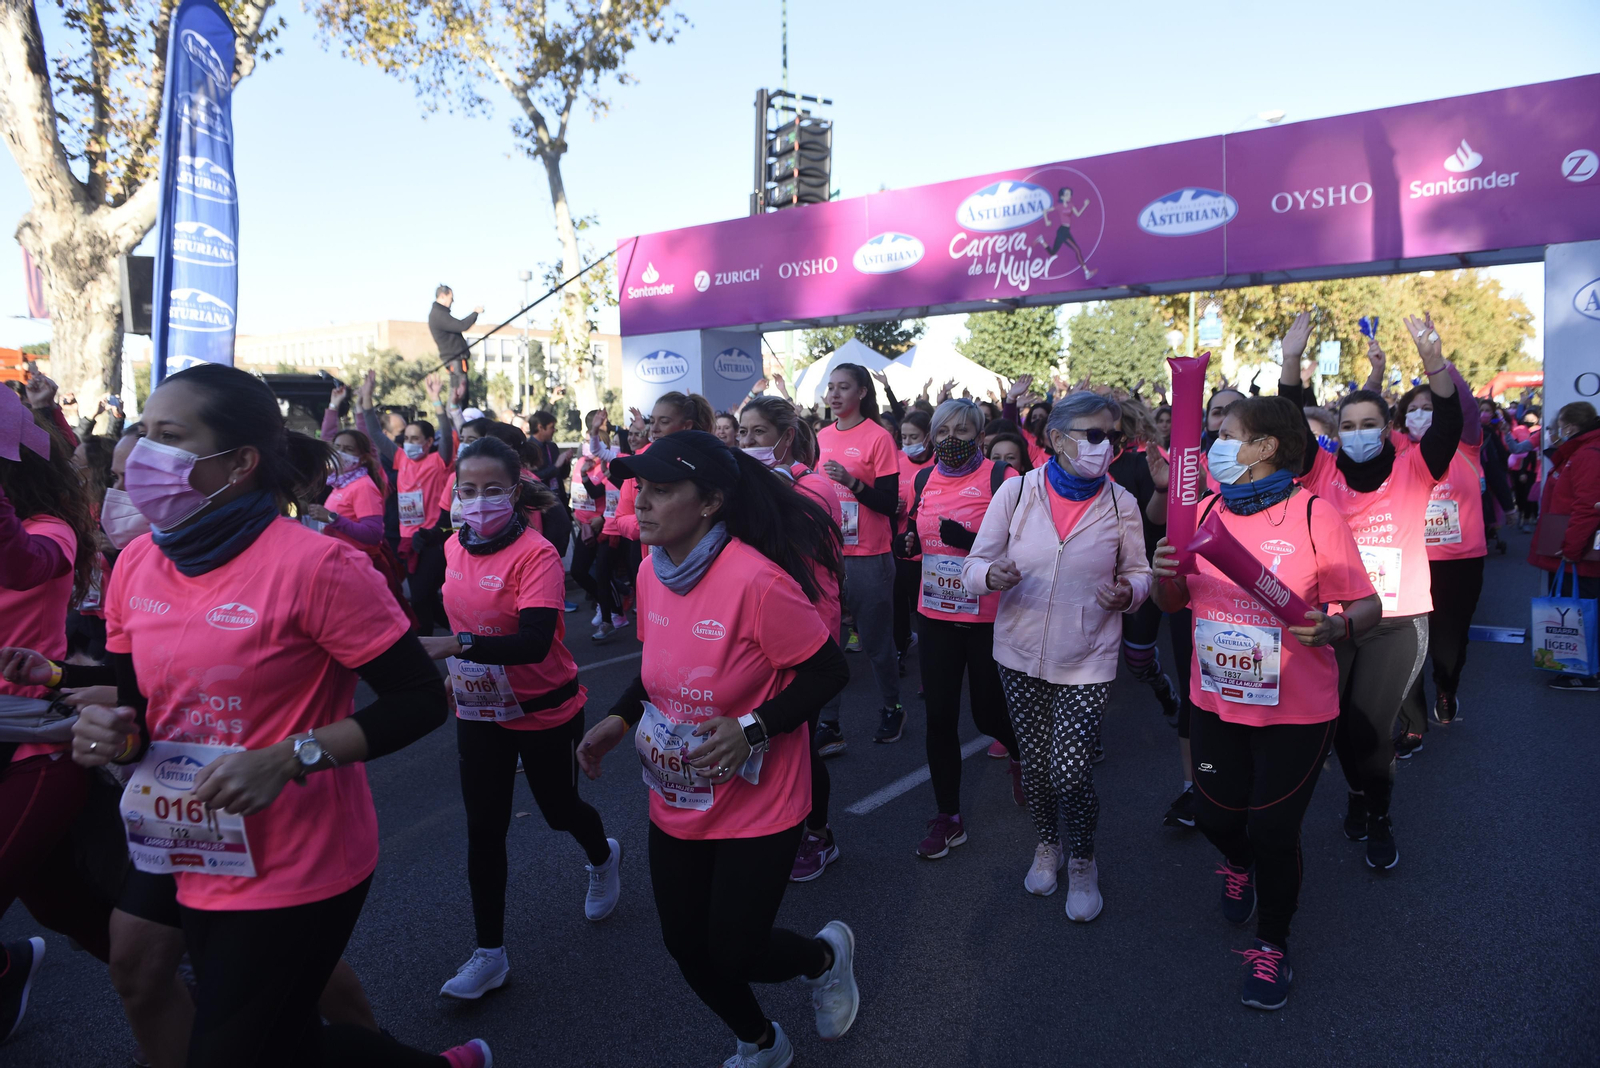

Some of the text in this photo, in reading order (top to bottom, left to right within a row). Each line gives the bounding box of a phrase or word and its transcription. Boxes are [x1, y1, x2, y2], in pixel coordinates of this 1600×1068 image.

[177, 171, 234, 197] STURIAN
[1410, 171, 1519, 198] Santander
[1271, 182, 1373, 213] OYSHO
[965, 200, 1044, 222] ASTURIANA
[1147, 206, 1229, 228] ASTURIANA
[174, 239, 235, 264] STURIANA
[949, 232, 1027, 259] Carrera
[863, 249, 918, 266] ASTURIANA
[779, 256, 838, 279] OYSHO
[968, 247, 1058, 291] de la Mujer
[715, 268, 760, 286] ZURICH
[627, 283, 674, 299] Santander
[169, 306, 230, 326] STURIANA
[641, 363, 685, 376] ASTURIANA
[717, 359, 753, 374] ASTURIANA
[1182, 446, 1200, 506] Ladival
[1369, 513, 1392, 523] POR
[1264, 543, 1292, 553] ASTURIANA
[1354, 535, 1393, 544] OTRAS
[938, 577, 961, 589] 016
[1255, 564, 1291, 607] Ladival
[210, 611, 254, 624] ASTURIANA
[1208, 611, 1277, 625] NOSOTRAS
[1556, 607, 1571, 627] Y
[478, 624, 501, 634] POR
[1217, 636, 1252, 648] ASTURIANA
[1216, 653, 1251, 670] 016
[1224, 670, 1241, 679] 1837
[465, 680, 492, 692] 016
[681, 687, 713, 701] POR
[199, 693, 242, 712] POR
[667, 698, 714, 717] TODAS
[181, 708, 243, 734] TODAS
[651, 747, 680, 772] 016
[157, 766, 198, 783] ASTURIA
[155, 796, 203, 823] 016
